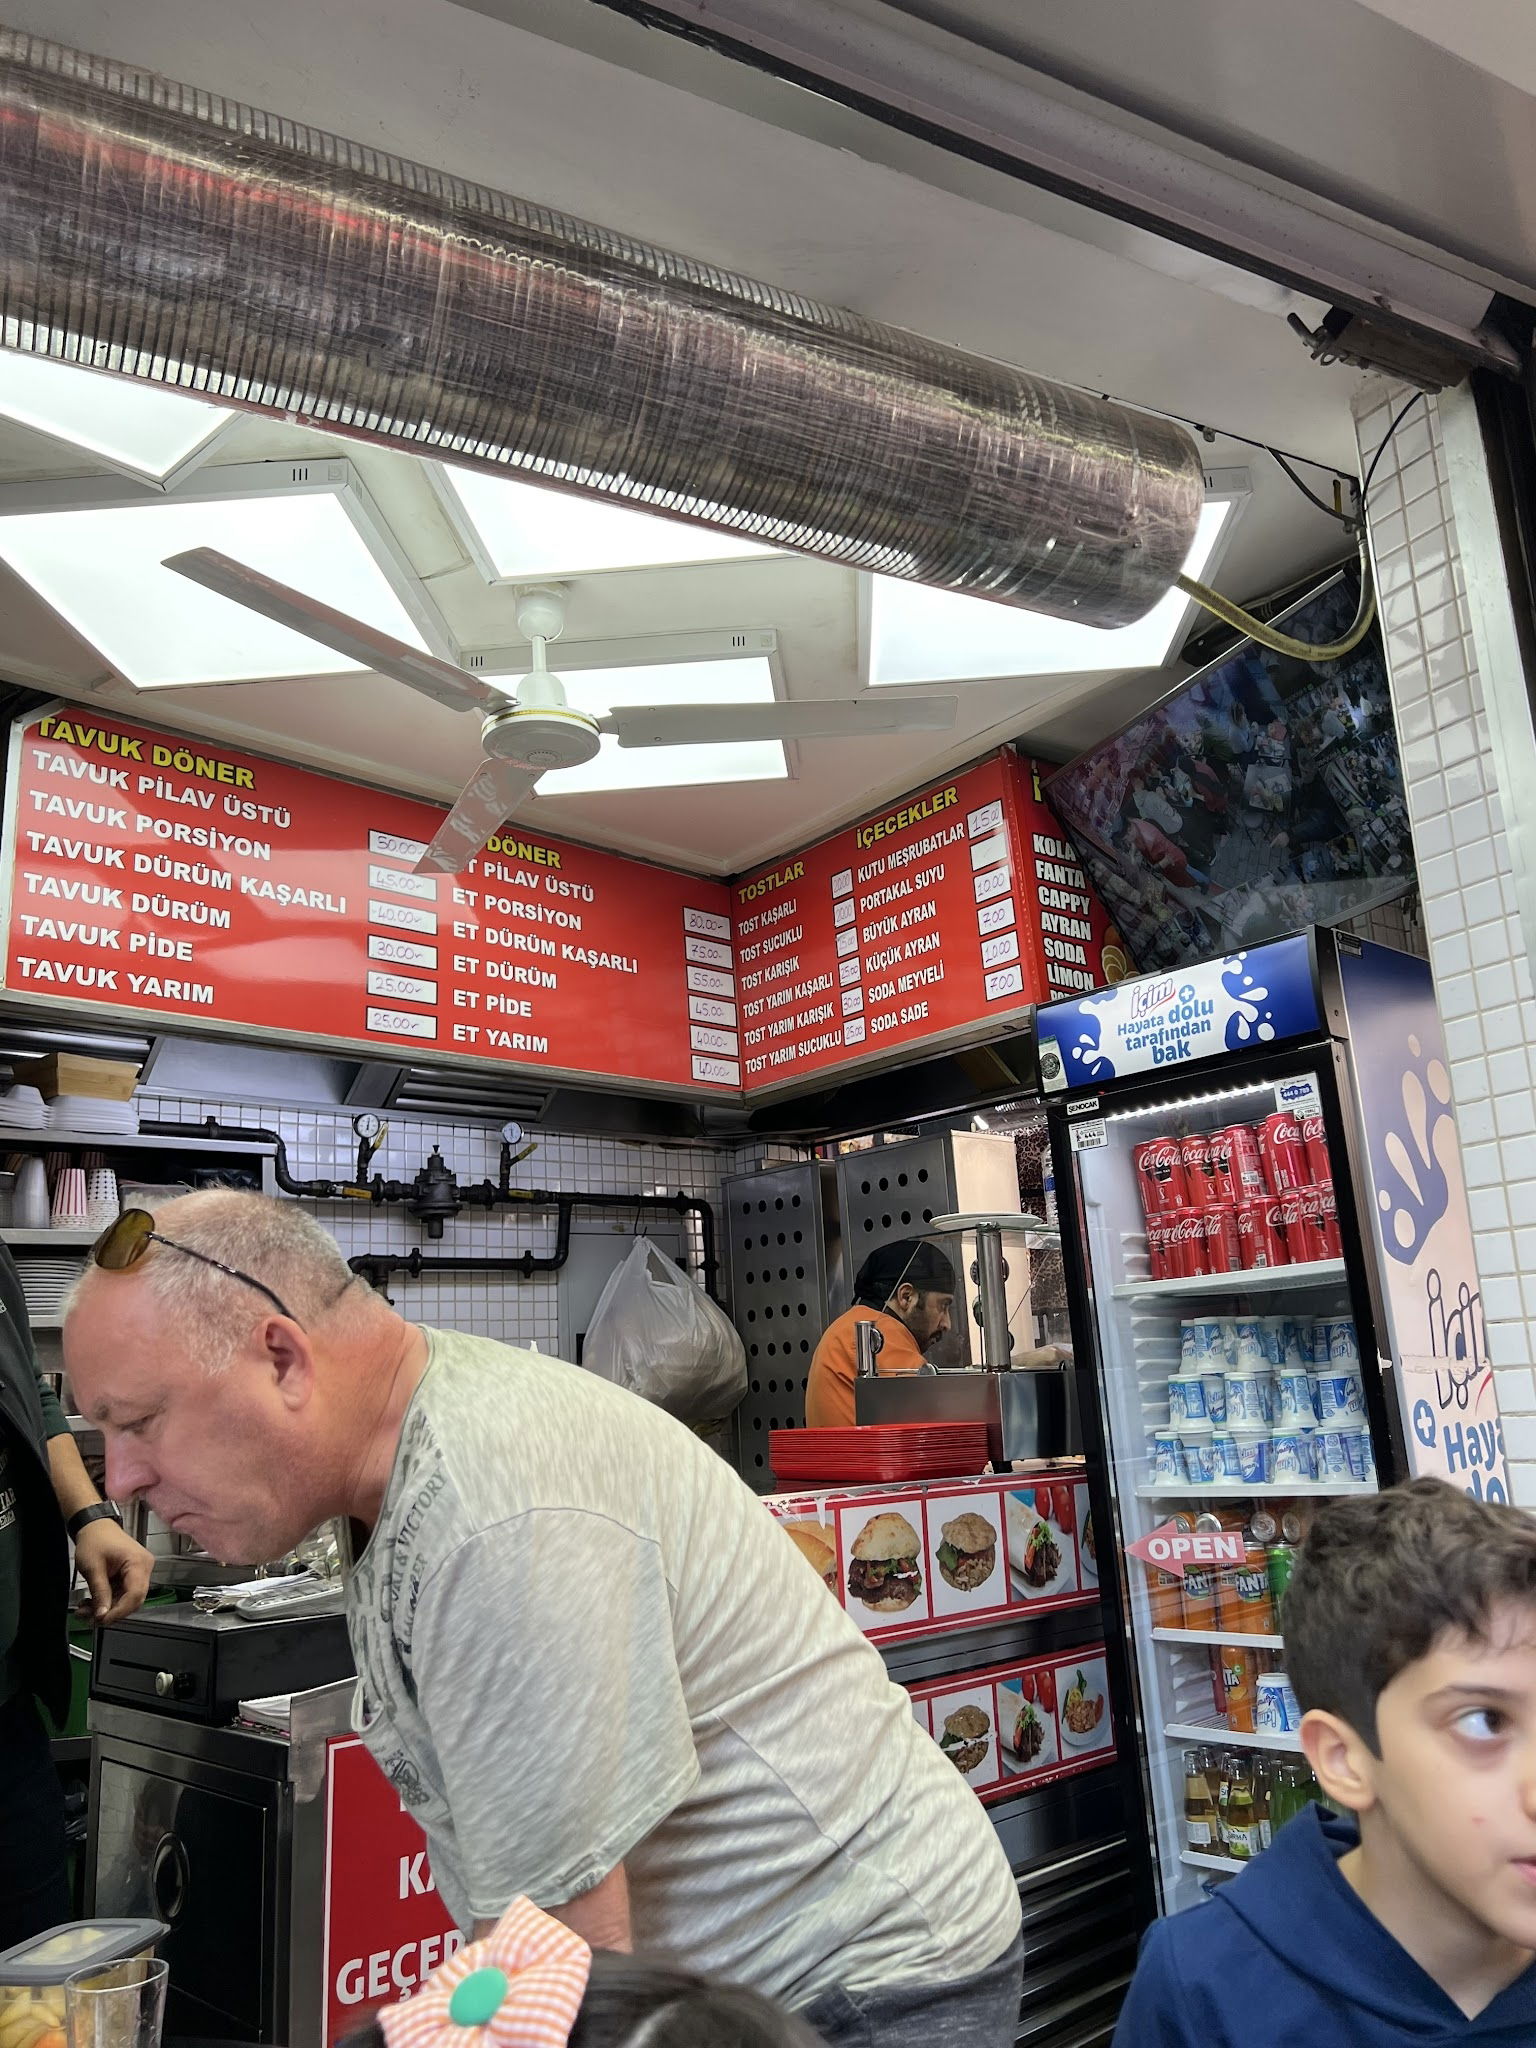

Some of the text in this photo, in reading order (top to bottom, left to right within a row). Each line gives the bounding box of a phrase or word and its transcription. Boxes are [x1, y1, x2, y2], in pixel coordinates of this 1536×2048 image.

[38, 716, 256, 790] TAVUK DÖNER
[32, 749, 292, 829] TAVUK PİLAV ÜSTÜ
[29, 790, 272, 861] TAVUK PORSİYON
[857, 786, 959, 850] İÇECEKLER
[487, 834, 563, 869] DÖNER
[857, 822, 965, 884] KUTU MEŞRUBATLAR
[1032, 833, 1077, 862] KOLA
[26, 830, 347, 915] TAVUK DÜRÜM KAŞARLI
[484, 859, 539, 888] PİLAV
[545, 873, 594, 902] ÜSTÜ
[738, 861, 805, 904] TOSTLAR
[859, 864, 945, 914] PORTAKAL SUYU
[1035, 859, 1086, 889] FANTA
[23, 872, 231, 929] TAVUK DÜRÜM
[452, 887, 582, 931] ET PORSİYON
[738, 899, 797, 936] TOST KAŞARLI
[863, 900, 937, 944] BÜYÜK AYRAN
[1038, 885, 1090, 916] CAPPY
[20, 914, 193, 962] TAVUK PİDE
[452, 920, 638, 974] ET DÜRÜM KAŞARLI
[740, 925, 803, 964] TOST SUCUKLU
[1041, 911, 1092, 941] AYRAN
[452, 955, 557, 989] ET DÜRÜM
[741, 955, 800, 991] TOST KARIŞIK
[866, 931, 941, 974] KÜÇÜK AYRAN
[1043, 937, 1087, 966] SODA
[17, 956, 214, 1004] TAVUK YARIM
[742, 972, 833, 1019] TOST YARIM KAŞARLI
[868, 959, 945, 1004] SODA MEYVELİ
[1046, 962, 1095, 991] LİMON
[452, 989, 532, 1018] ET PİDE
[744, 1001, 835, 1047] TOST YARIM KARIŞIK
[870, 1001, 929, 1034] SODA SADE
[1117, 998, 1214, 1037] Hayata dolu
[452, 1024, 549, 1054] ET YARIM
[745, 1030, 842, 1074] TOST YARIM SUCUKLU
[1126, 1017, 1211, 1052] tarafından
[1152, 1038, 1192, 1065] bak
[1148, 1536, 1238, 1561] OPEN
